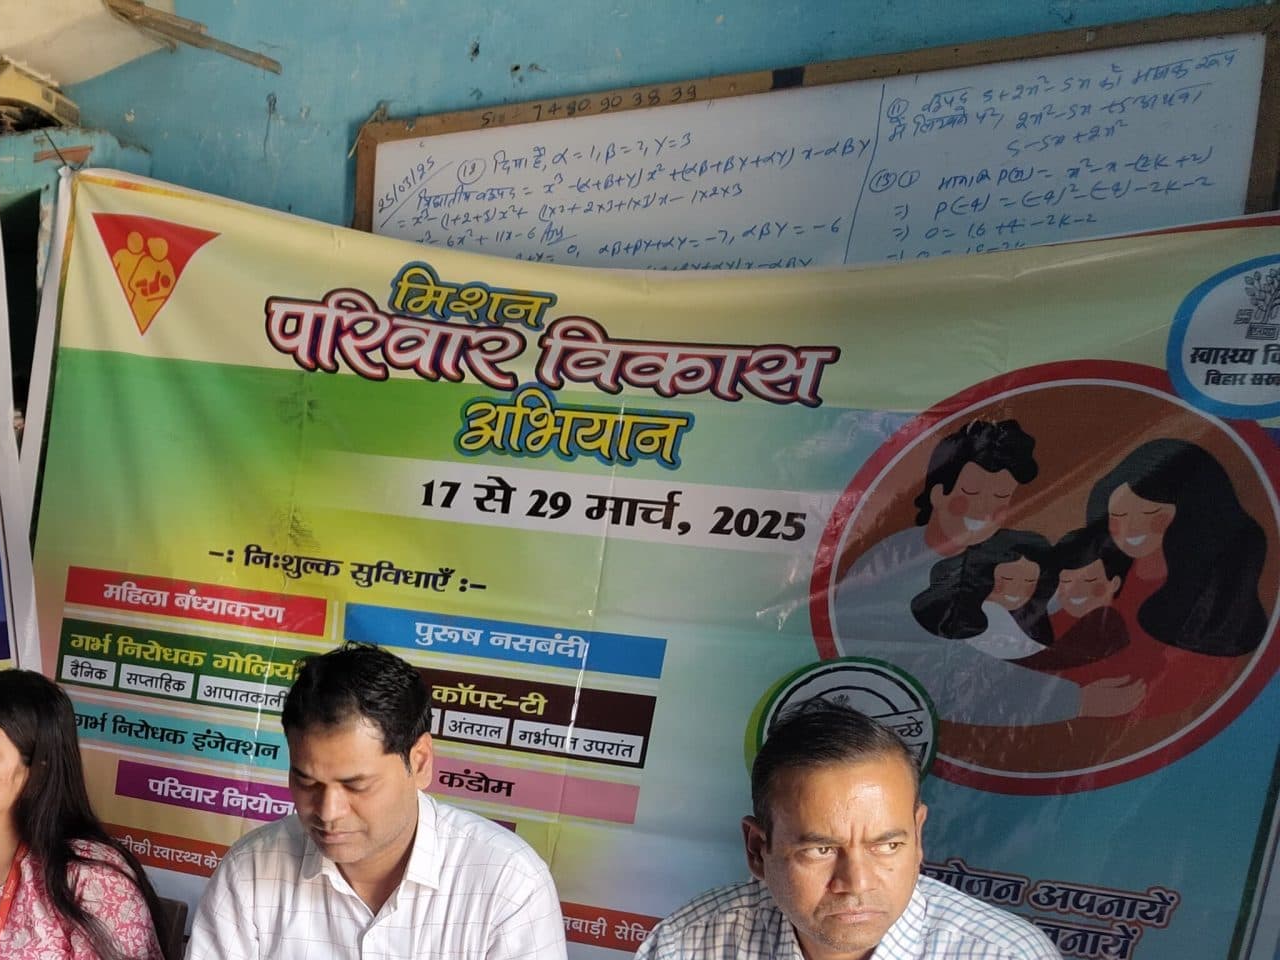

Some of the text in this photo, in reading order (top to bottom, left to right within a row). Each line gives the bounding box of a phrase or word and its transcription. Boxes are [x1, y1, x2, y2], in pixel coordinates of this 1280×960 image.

[391, 261, 557, 329] मिशन
[266, 288, 840, 407] परिवार विकास
[1190, 346, 1259, 365] स्वास्थ्य
[1205, 369, 1246, 386] बिहार
[455, 382, 694, 469] अभियान
[421, 476, 807, 542] 17 से 29 मार्च, 2025
[350, 560, 456, 593] सुविधाएँ
[103, 581, 286, 624] महिला बंध्याकरण
[70, 632, 113, 655] गर्भ
[116, 635, 208, 668] निरोधक
[490, 632, 589, 660] नसबंदी
[70, 659, 289, 710] दैनिक सप्ताहिक आपातकाली
[431, 682, 550, 717] कॉपर-टी
[112, 712, 189, 746] निरोधक
[192, 727, 281, 761] इंजेक्शन
[447, 716, 504, 741] अंतराल
[582, 735, 636, 760] उपरांत
[148, 776, 296, 816] परिवार नियोज
[438, 768, 516, 799] कंडोम
[153, 845, 203, 866] स्वास्थ्य
[1031, 881, 1179, 928] अपनायें
